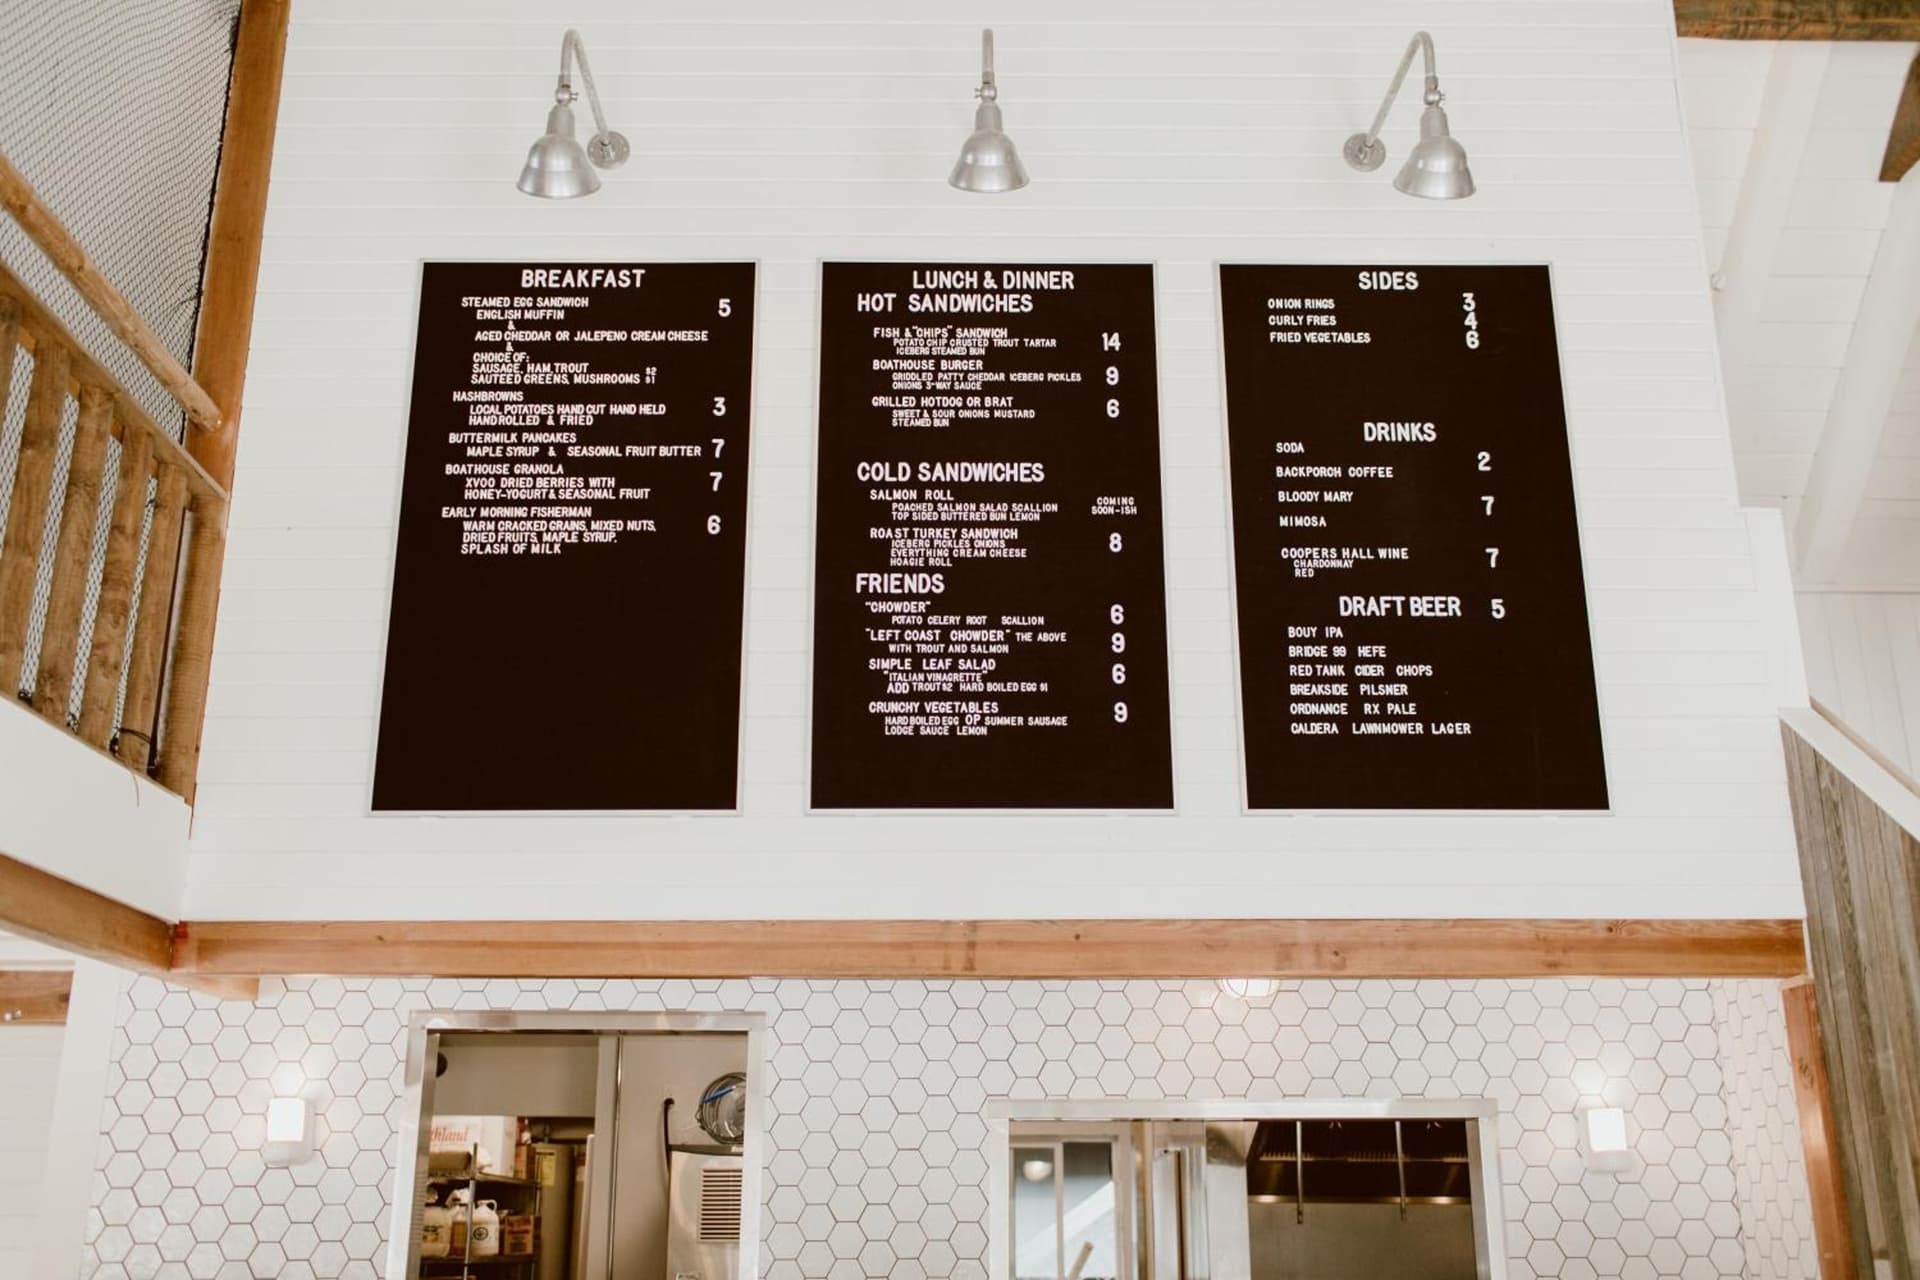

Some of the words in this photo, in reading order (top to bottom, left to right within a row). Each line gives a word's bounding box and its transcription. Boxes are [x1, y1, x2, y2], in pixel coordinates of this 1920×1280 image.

[522, 270, 645, 288] BREAKFAST
[913, 271, 977, 289] LUNCH
[983, 271, 998, 289] &
[1003, 271, 1074, 289] DINNER
[1358, 272, 1419, 290] SIDES
[462, 298, 510, 307] STEAMED
[514, 298, 533, 307] EGG
[536, 298, 589, 307] SANDWICH
[857, 294, 896, 312] HOT
[908, 294, 1033, 312] SANDWICHES
[1268, 299, 1301, 309] ONION
[1304, 299, 1335, 309] RINGS
[1462, 293, 1475, 311] 3
[718, 299, 731, 317] 5
[476, 310, 521, 320] ENGLISH
[524, 310, 564, 320] MUFFIN
[1268, 315, 1303, 326] CURLY
[1307, 315, 1337, 326] FRIES
[1464, 312, 1478, 330] 4
[475, 331, 502, 341] AGED
[505, 331, 551, 341] CHEDDAR
[556, 331, 570, 341] OR
[574, 331, 627, 341] JALEPENO
[631, 331, 665, 341] CREAM
[667, 331, 708, 341] CHEESE
[874, 327, 900, 338] FISH
[905, 327, 912, 338] &
[956, 327, 1008, 338] SANDWICH
[1270, 332, 1301, 343] FRIED
[1304, 332, 1371, 343] VEGETABLES
[1102, 332, 1121, 351] 14
[1466, 331, 1480, 349] 6
[473, 353, 511, 362] CHOICE
[873, 360, 935, 370] BOATHOUSE
[941, 360, 983, 370] BURGER
[471, 374, 522, 385] SAUTEED
[574, 374, 640, 385] MUSHROOMS
[1106, 366, 1119, 386] 9
[453, 392, 524, 401] HASHBROWNS
[872, 397, 916, 407] GRILLED
[921, 397, 962, 407] HOTDOG
[967, 397, 981, 407] OR
[984, 397, 1013, 407] BRAT
[713, 397, 726, 416] 3
[1106, 399, 1120, 418] 6
[1364, 422, 1436, 442] DRINKS
[449, 433, 517, 443] BUTTERMILK
[522, 433, 576, 443] PANCAKES
[467, 447, 503, 457] MAPLE
[505, 447, 539, 457] SYRUP
[548, 447, 556, 457] &
[567, 447, 622, 457] SEASONAL
[625, 447, 657, 457] FRUIT
[659, 447, 701, 457] BUTTER
[711, 438, 725, 458] 7
[1276, 443, 1304, 453] SODA
[1477, 452, 1491, 471] 2
[445, 464, 510, 474] BOATHOUSE
[514, 464, 564, 474] GRANOLA
[857, 462, 911, 482] COLD
[918, 462, 1045, 482] SANDWICHES
[1276, 467, 1341, 478] BACKPORCH
[1348, 467, 1394, 478] COFFEE
[500, 478, 534, 488] DRIED
[536, 478, 584, 488] BERRIES
[589, 478, 615, 488] WITH
[709, 471, 723, 492] 7
[870, 490, 917, 500] SALMON
[925, 490, 954, 500] ROLL
[1278, 492, 1319, 502] BLOODY
[1323, 492, 1353, 502] MARY
[1097, 497, 1135, 506] COMING
[1481, 496, 1495, 516] 7
[442, 507, 476, 518] EARLY
[480, 507, 528, 518] MORNING
[530, 507, 592, 518] FISHERMAN
[892, 503, 933, 512] POACHED
[937, 503, 976, 512] SALMON
[979, 503, 1008, 512] SALAD
[1012, 503, 1058, 512] SCALLION
[1091, 506, 1137, 515] SOON-ISH
[463, 521, 495, 532] WARM
[498, 521, 547, 532] CRACKED
[591, 521, 624, 532] MIXED
[707, 515, 721, 535] 6
[1279, 517, 1327, 527] MIMOSA
[463, 533, 496, 543] DRIED
[542, 533, 578, 543] MAPLE
[870, 528, 909, 539] ROAST
[913, 528, 958, 539] TURKEY
[961, 528, 1018, 539] SANDWICH
[1109, 533, 1122, 552] 8
[461, 544, 508, 554] SPLASH
[512, 544, 527, 554] OF
[531, 544, 561, 554] MILK
[1281, 548, 1337, 559] COOPERS
[1342, 548, 1374, 559] HALL
[1378, 548, 1409, 559] WINE
[1485, 548, 1499, 568] 7
[1294, 560, 1354, 568] CHARDONNAY
[1295, 569, 1314, 577] RED
[856, 574, 944, 593] FRIENDS
[1339, 596, 1405, 616] DRAFT
[1410, 596, 1461, 616] BEER
[1491, 599, 1505, 619] 5
[1110, 604, 1125, 625] 6
[892, 616, 922, 625] POTATO
[927, 616, 961, 625] CELERY
[966, 616, 987, 625] ROOT
[1001, 616, 1044, 625] SCALLION
[904, 630, 941, 641] COAST
[1016, 632, 1032, 642] THE
[1037, 632, 1067, 642] ABOVE
[1288, 627, 1317, 638] BOUY
[1325, 627, 1343, 638] IPA
[1111, 633, 1126, 653] 9
[1289, 646, 1328, 657] BRIDGE
[1358, 646, 1386, 657] HEFE
[869, 659, 912, 670] SIMPLE
[922, 659, 952, 670] LEAF
[958, 659, 996, 670] SALAD
[1112, 664, 1126, 684] 6
[1290, 665, 1312, 676] RED
[1316, 665, 1345, 676] TANK
[1355, 665, 1384, 676] CIDER
[1396, 665, 1433, 676] CHOPS
[1290, 684, 1348, 695] BREAKSIDE
[1360, 684, 1408, 695] PILSNER
[868, 702, 919, 713] CRUNCHY
[924, 702, 999, 713] VEGETABLES
[1113, 702, 1128, 723] 9
[1290, 704, 1348, 715] ORDNANCE
[1364, 704, 1380, 715] RX
[1387, 704, 1416, 715] PALE
[1291, 723, 1338, 734] CALDERA
[1352, 723, 1424, 734] LAWNMOWER
[1432, 723, 1471, 734] LAGER
